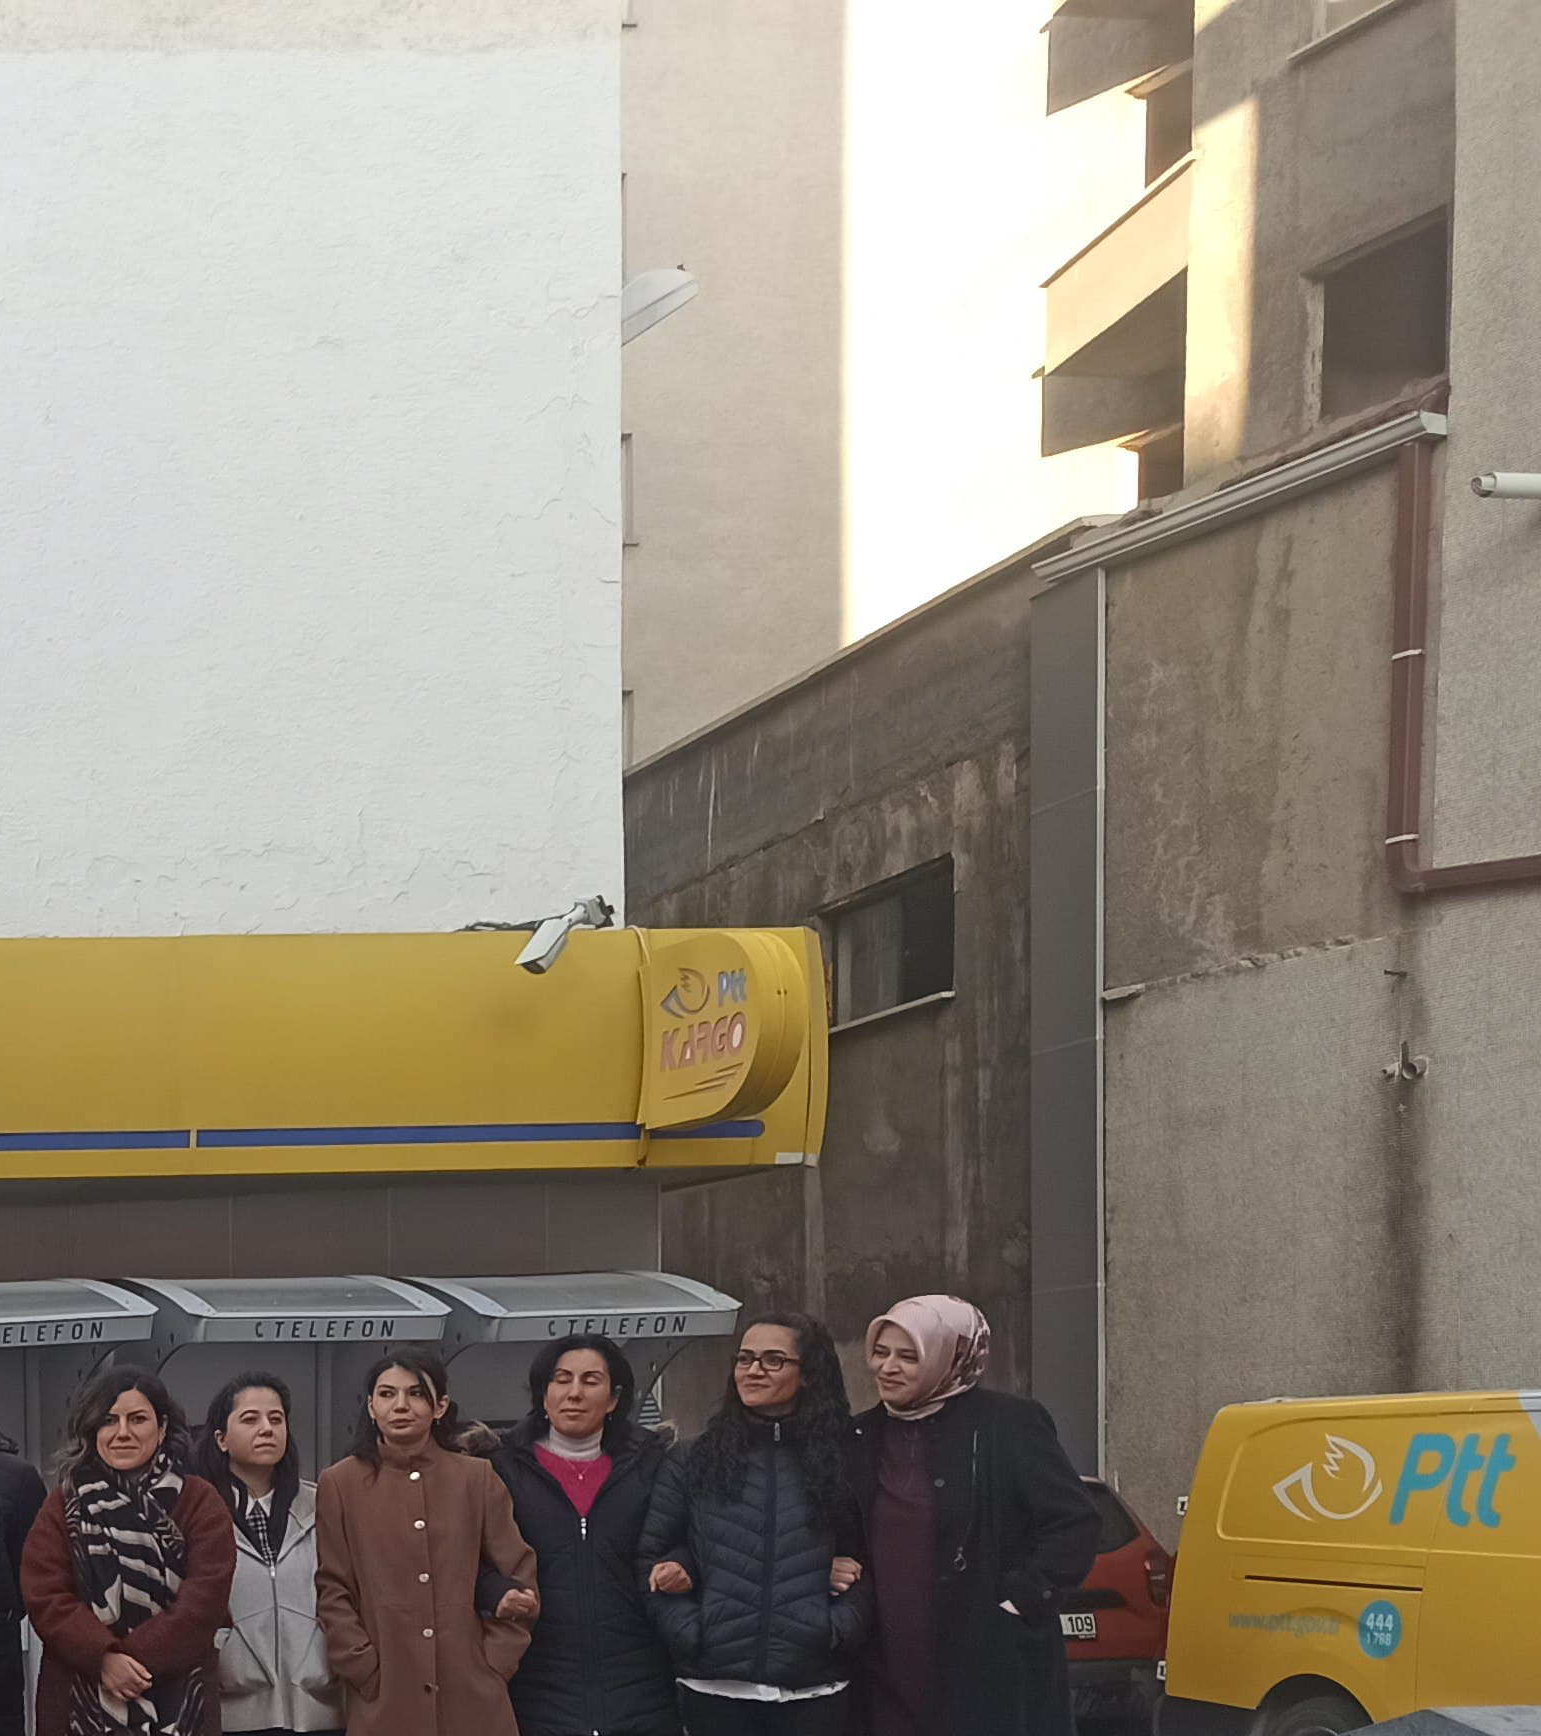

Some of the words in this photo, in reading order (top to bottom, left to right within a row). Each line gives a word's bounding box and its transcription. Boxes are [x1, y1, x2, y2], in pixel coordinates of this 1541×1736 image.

[717, 967, 749, 1008] Ptt
[659, 1010, 747, 1073] KARGO
[1388, 1432, 1517, 1529] Ptt
[1366, 1613, 1394, 1632] 444
